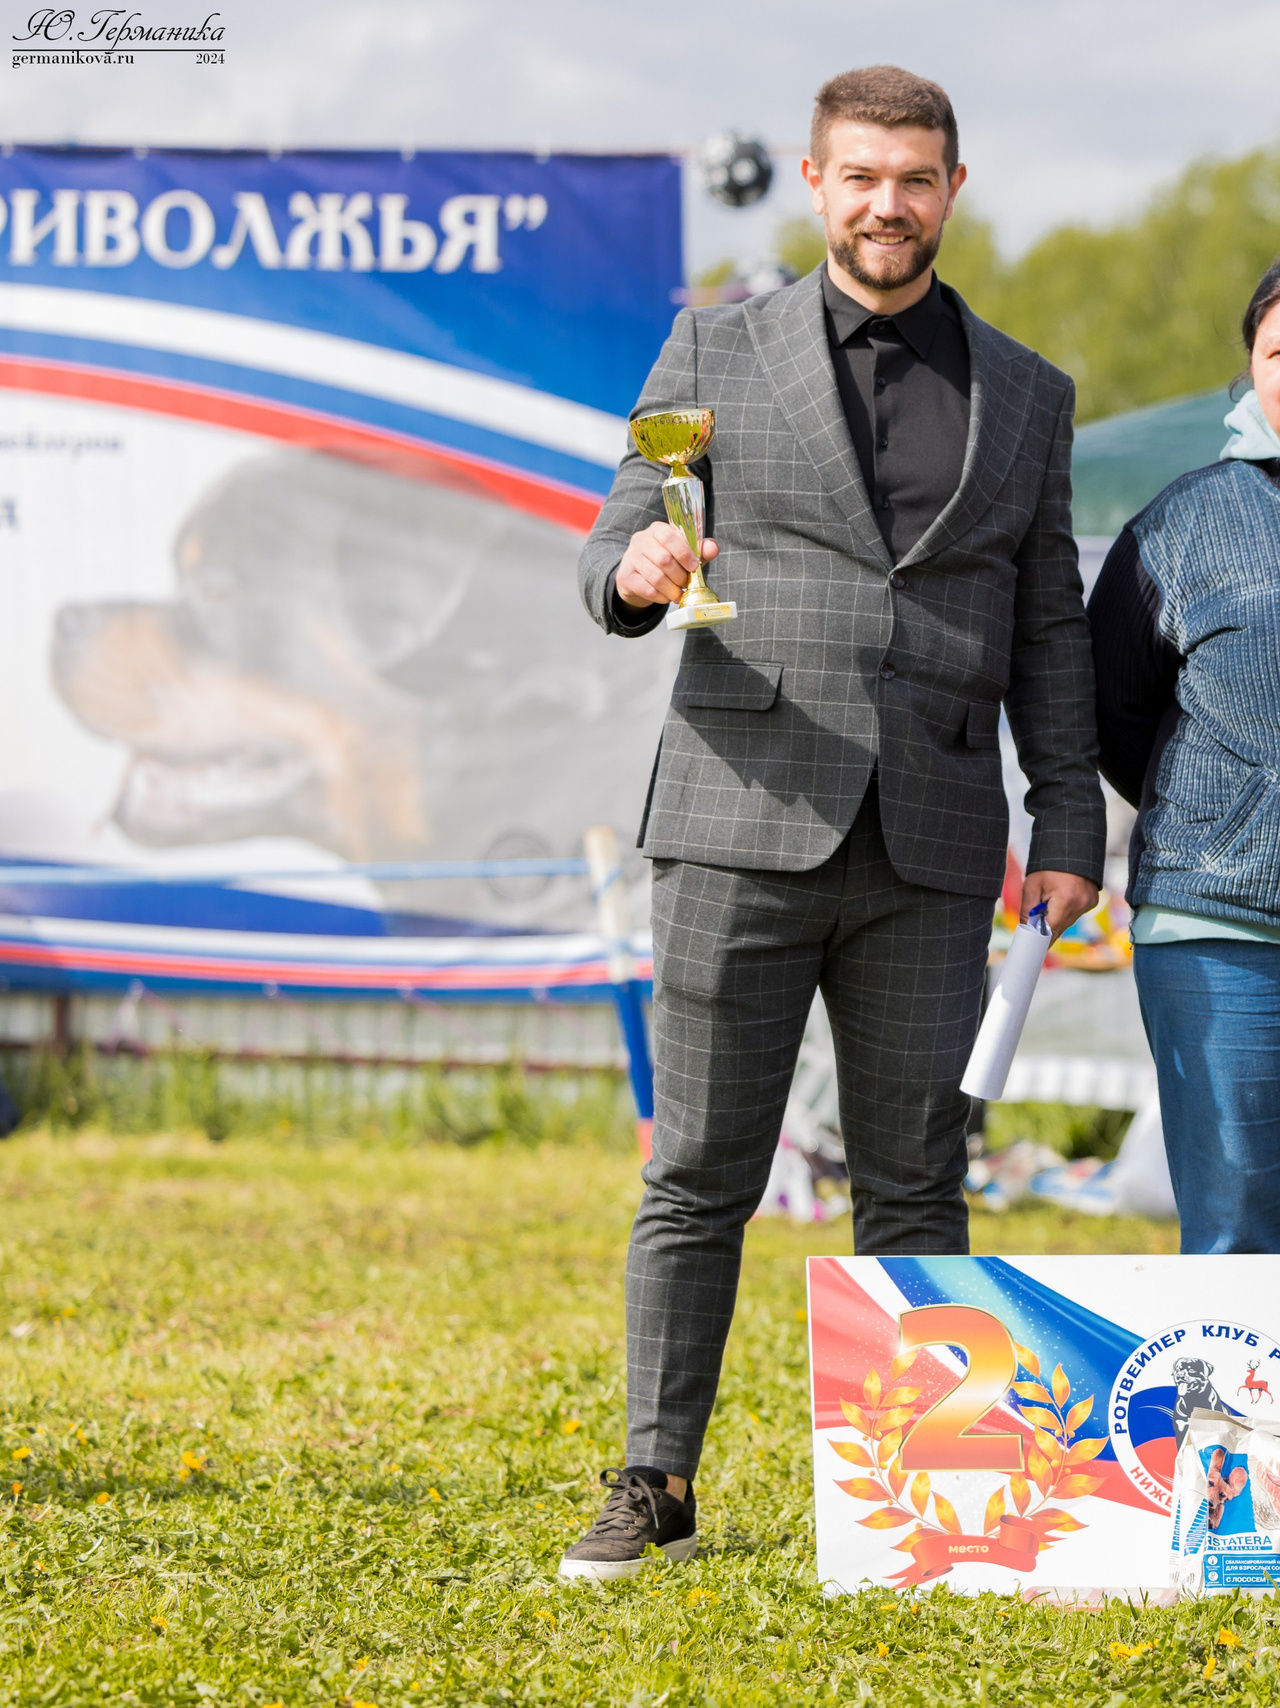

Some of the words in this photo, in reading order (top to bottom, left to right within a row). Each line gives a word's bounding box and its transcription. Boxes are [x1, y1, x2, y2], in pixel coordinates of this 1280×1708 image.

[0, 188, 549, 275] ИВОЛЖЬЯ”
[899, 1303, 1025, 1472] 2
[1113, 1328, 1187, 1435] РОТВЕЙЛЕР
[1201, 1324, 1260, 1347] КЛУБ
[948, 1544, 990, 1554] место
